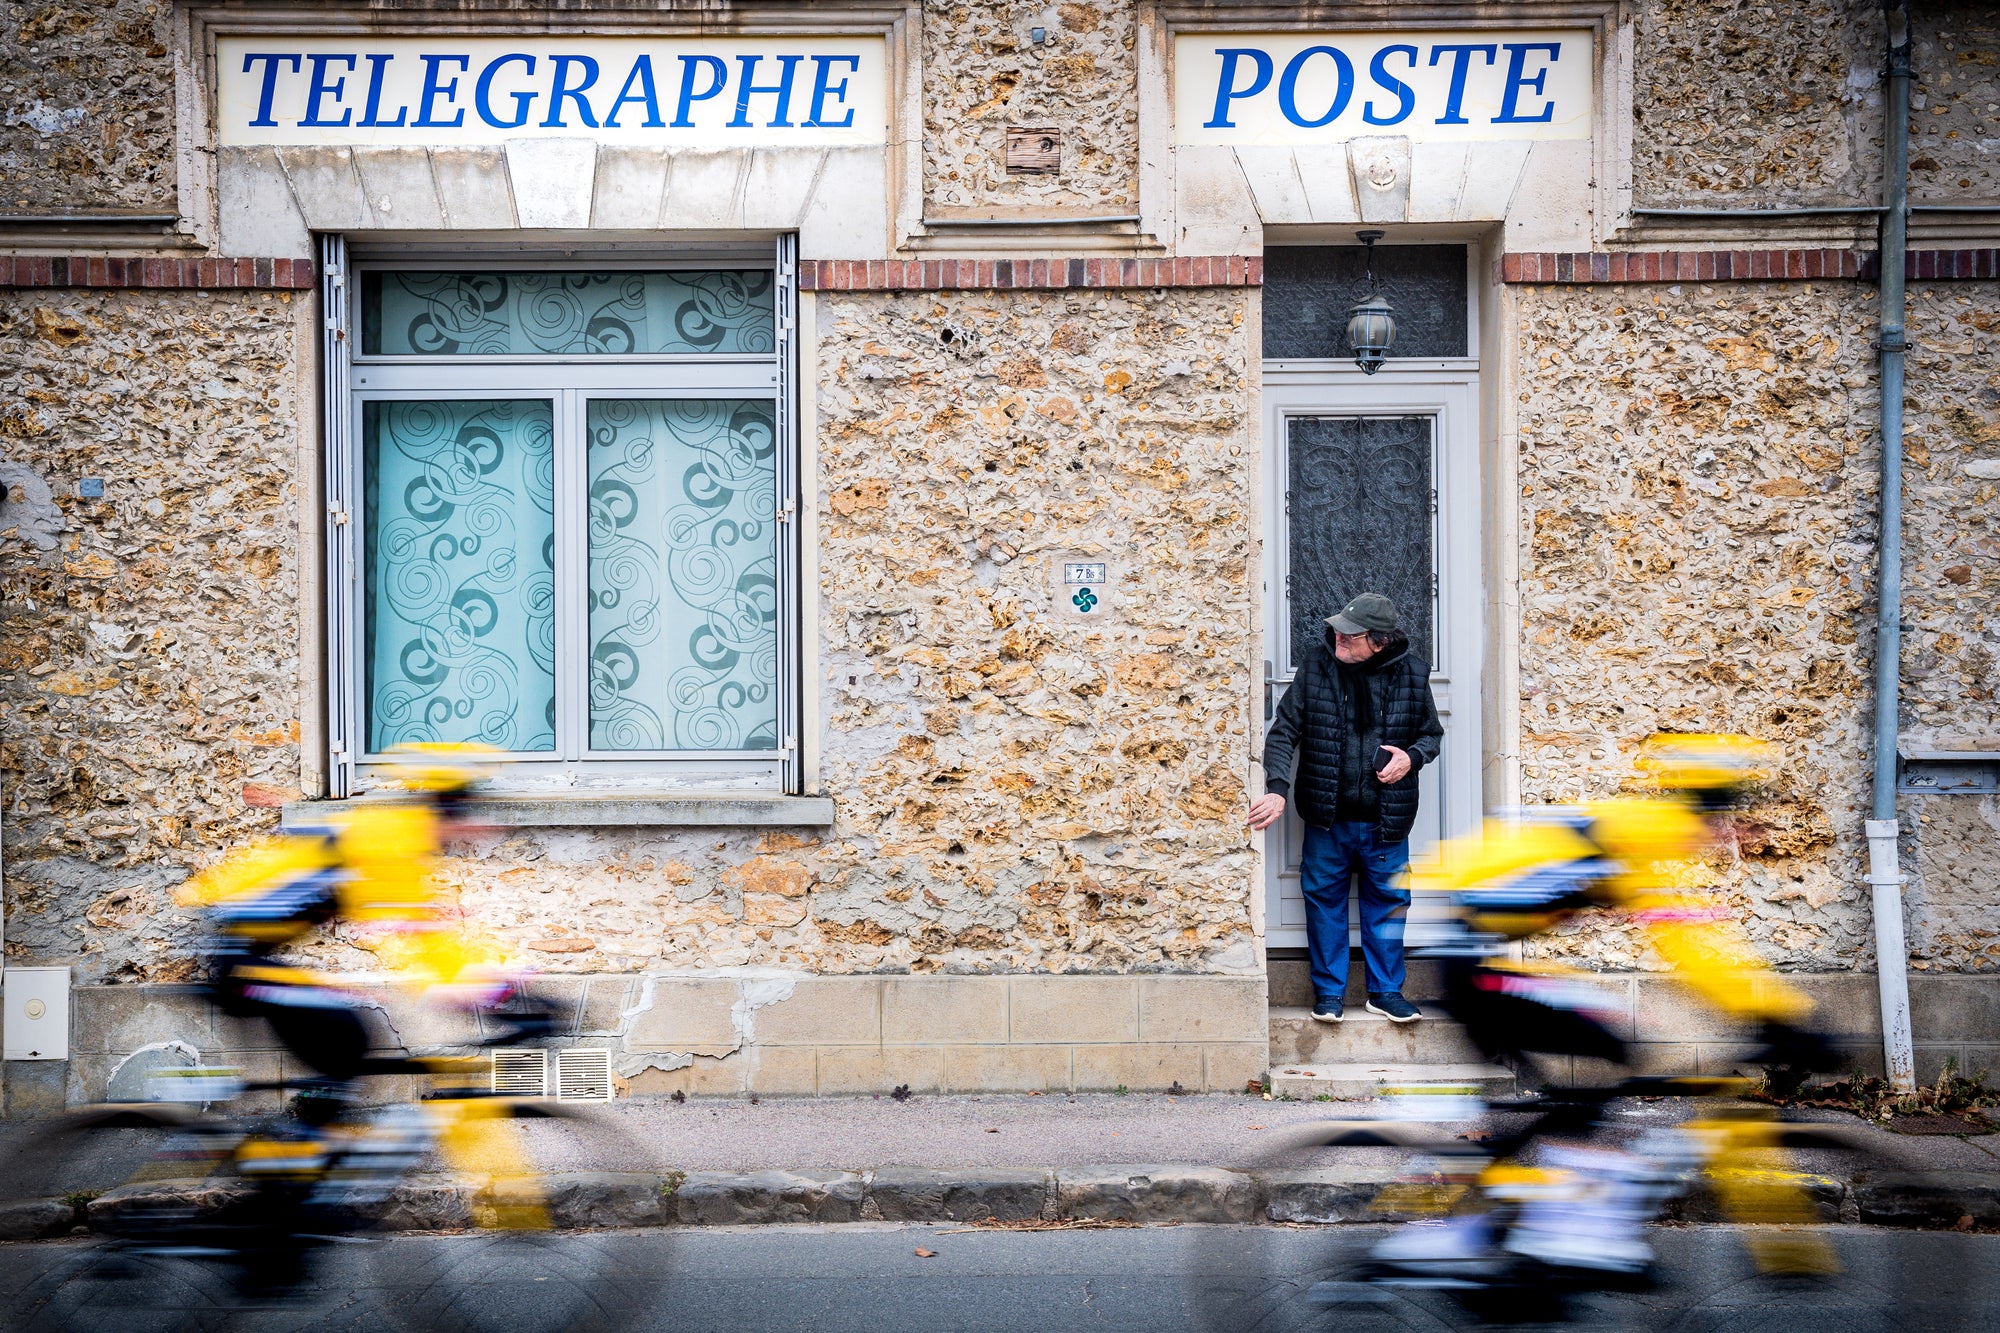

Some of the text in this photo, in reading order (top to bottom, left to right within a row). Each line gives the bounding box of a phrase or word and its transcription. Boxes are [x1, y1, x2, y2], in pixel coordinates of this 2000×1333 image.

[242, 53, 860, 129] TELEGRAPHE
[1203, 42, 1562, 129] POSTE
[1075, 568, 1084, 579] 7
